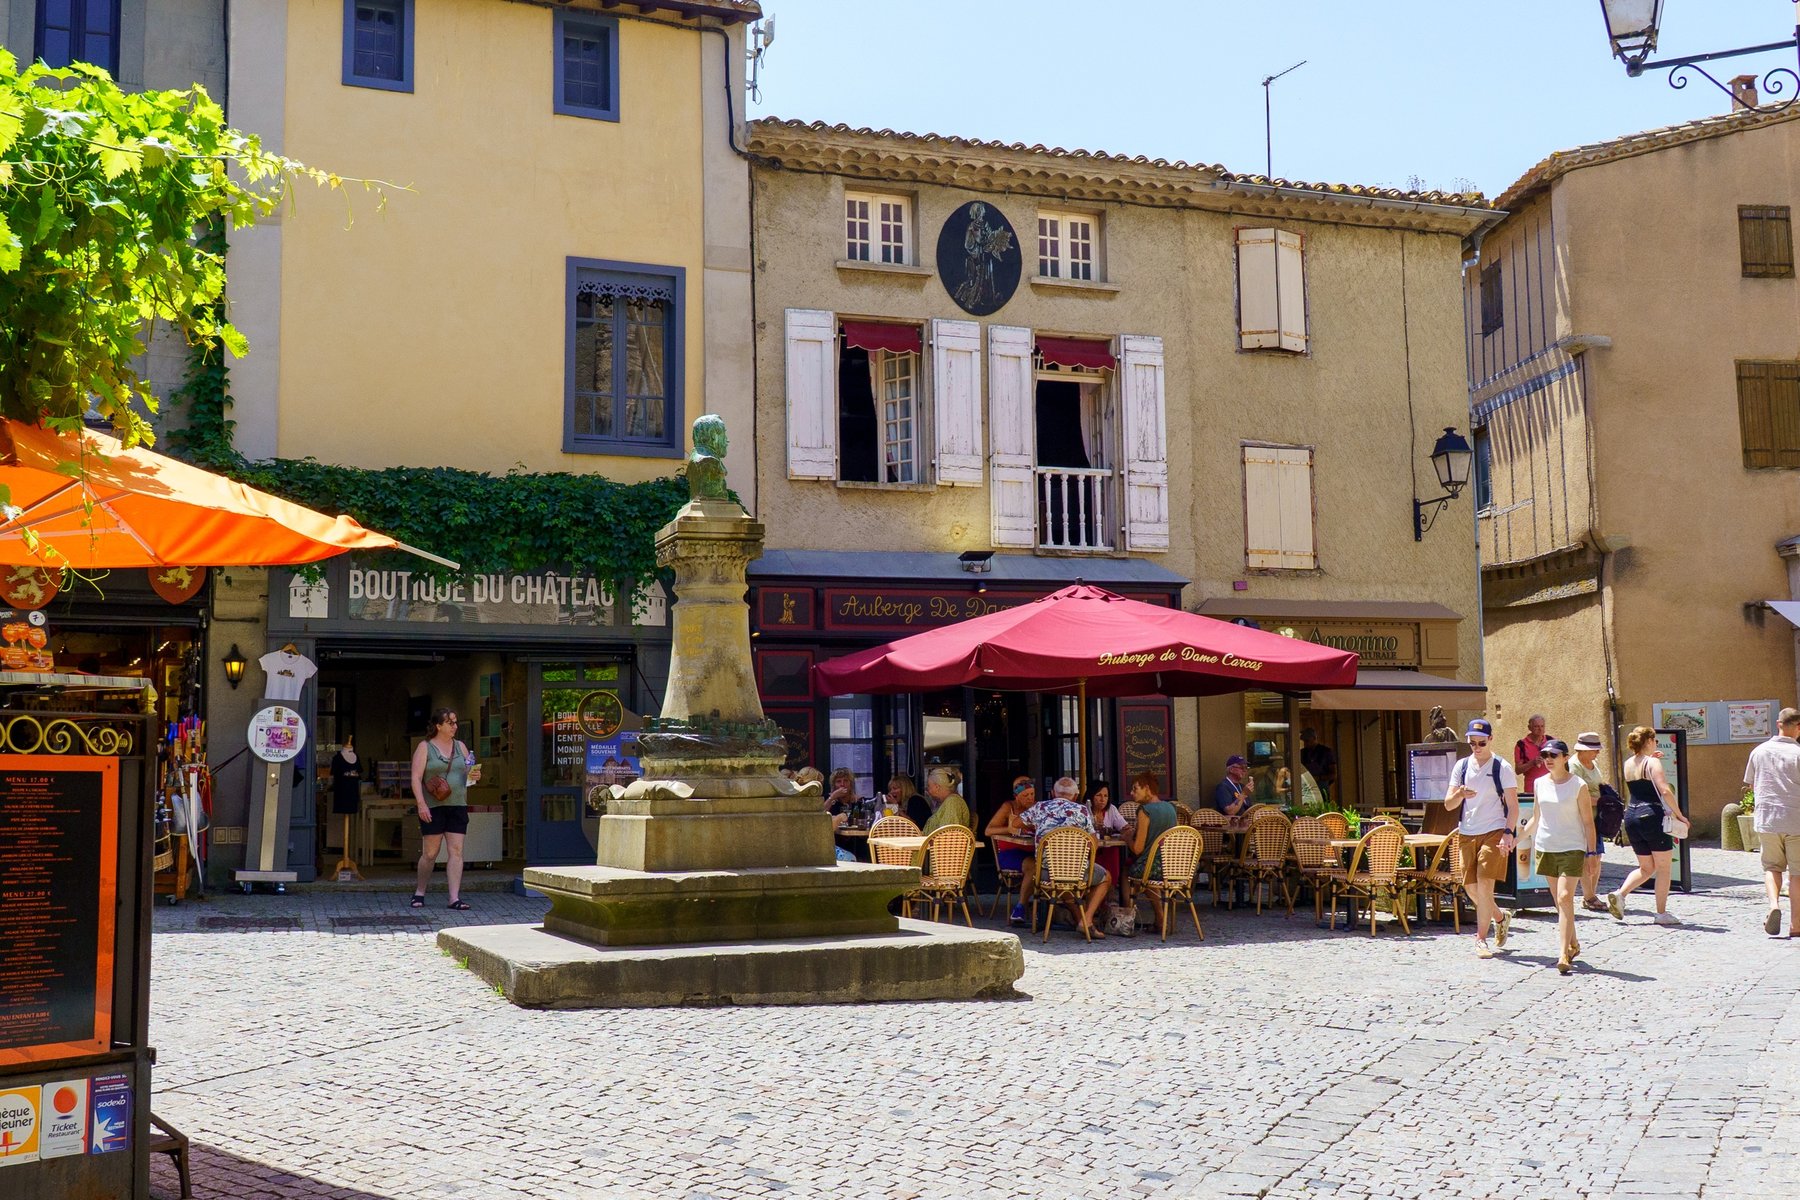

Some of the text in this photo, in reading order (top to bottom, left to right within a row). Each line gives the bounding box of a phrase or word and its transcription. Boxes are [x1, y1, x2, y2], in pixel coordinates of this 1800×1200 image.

[473, 574, 504, 604] DU
[511, 571, 615, 607] CHÂTEAU
[839, 595, 1017, 624] Auberge De Da
[1308, 626, 1398, 651] Amorino
[1098, 646, 1264, 672] Auberge de Dame Carcas
[557, 711, 595, 720] BOUTUE
[557, 734, 584, 742] CENTR
[97, 1096, 126, 1109] sodexo
[0, 1116, 33, 1130] euner
[51, 1122, 77, 1132] Ticket
[48, 1128, 81, 1138] Restaurant
